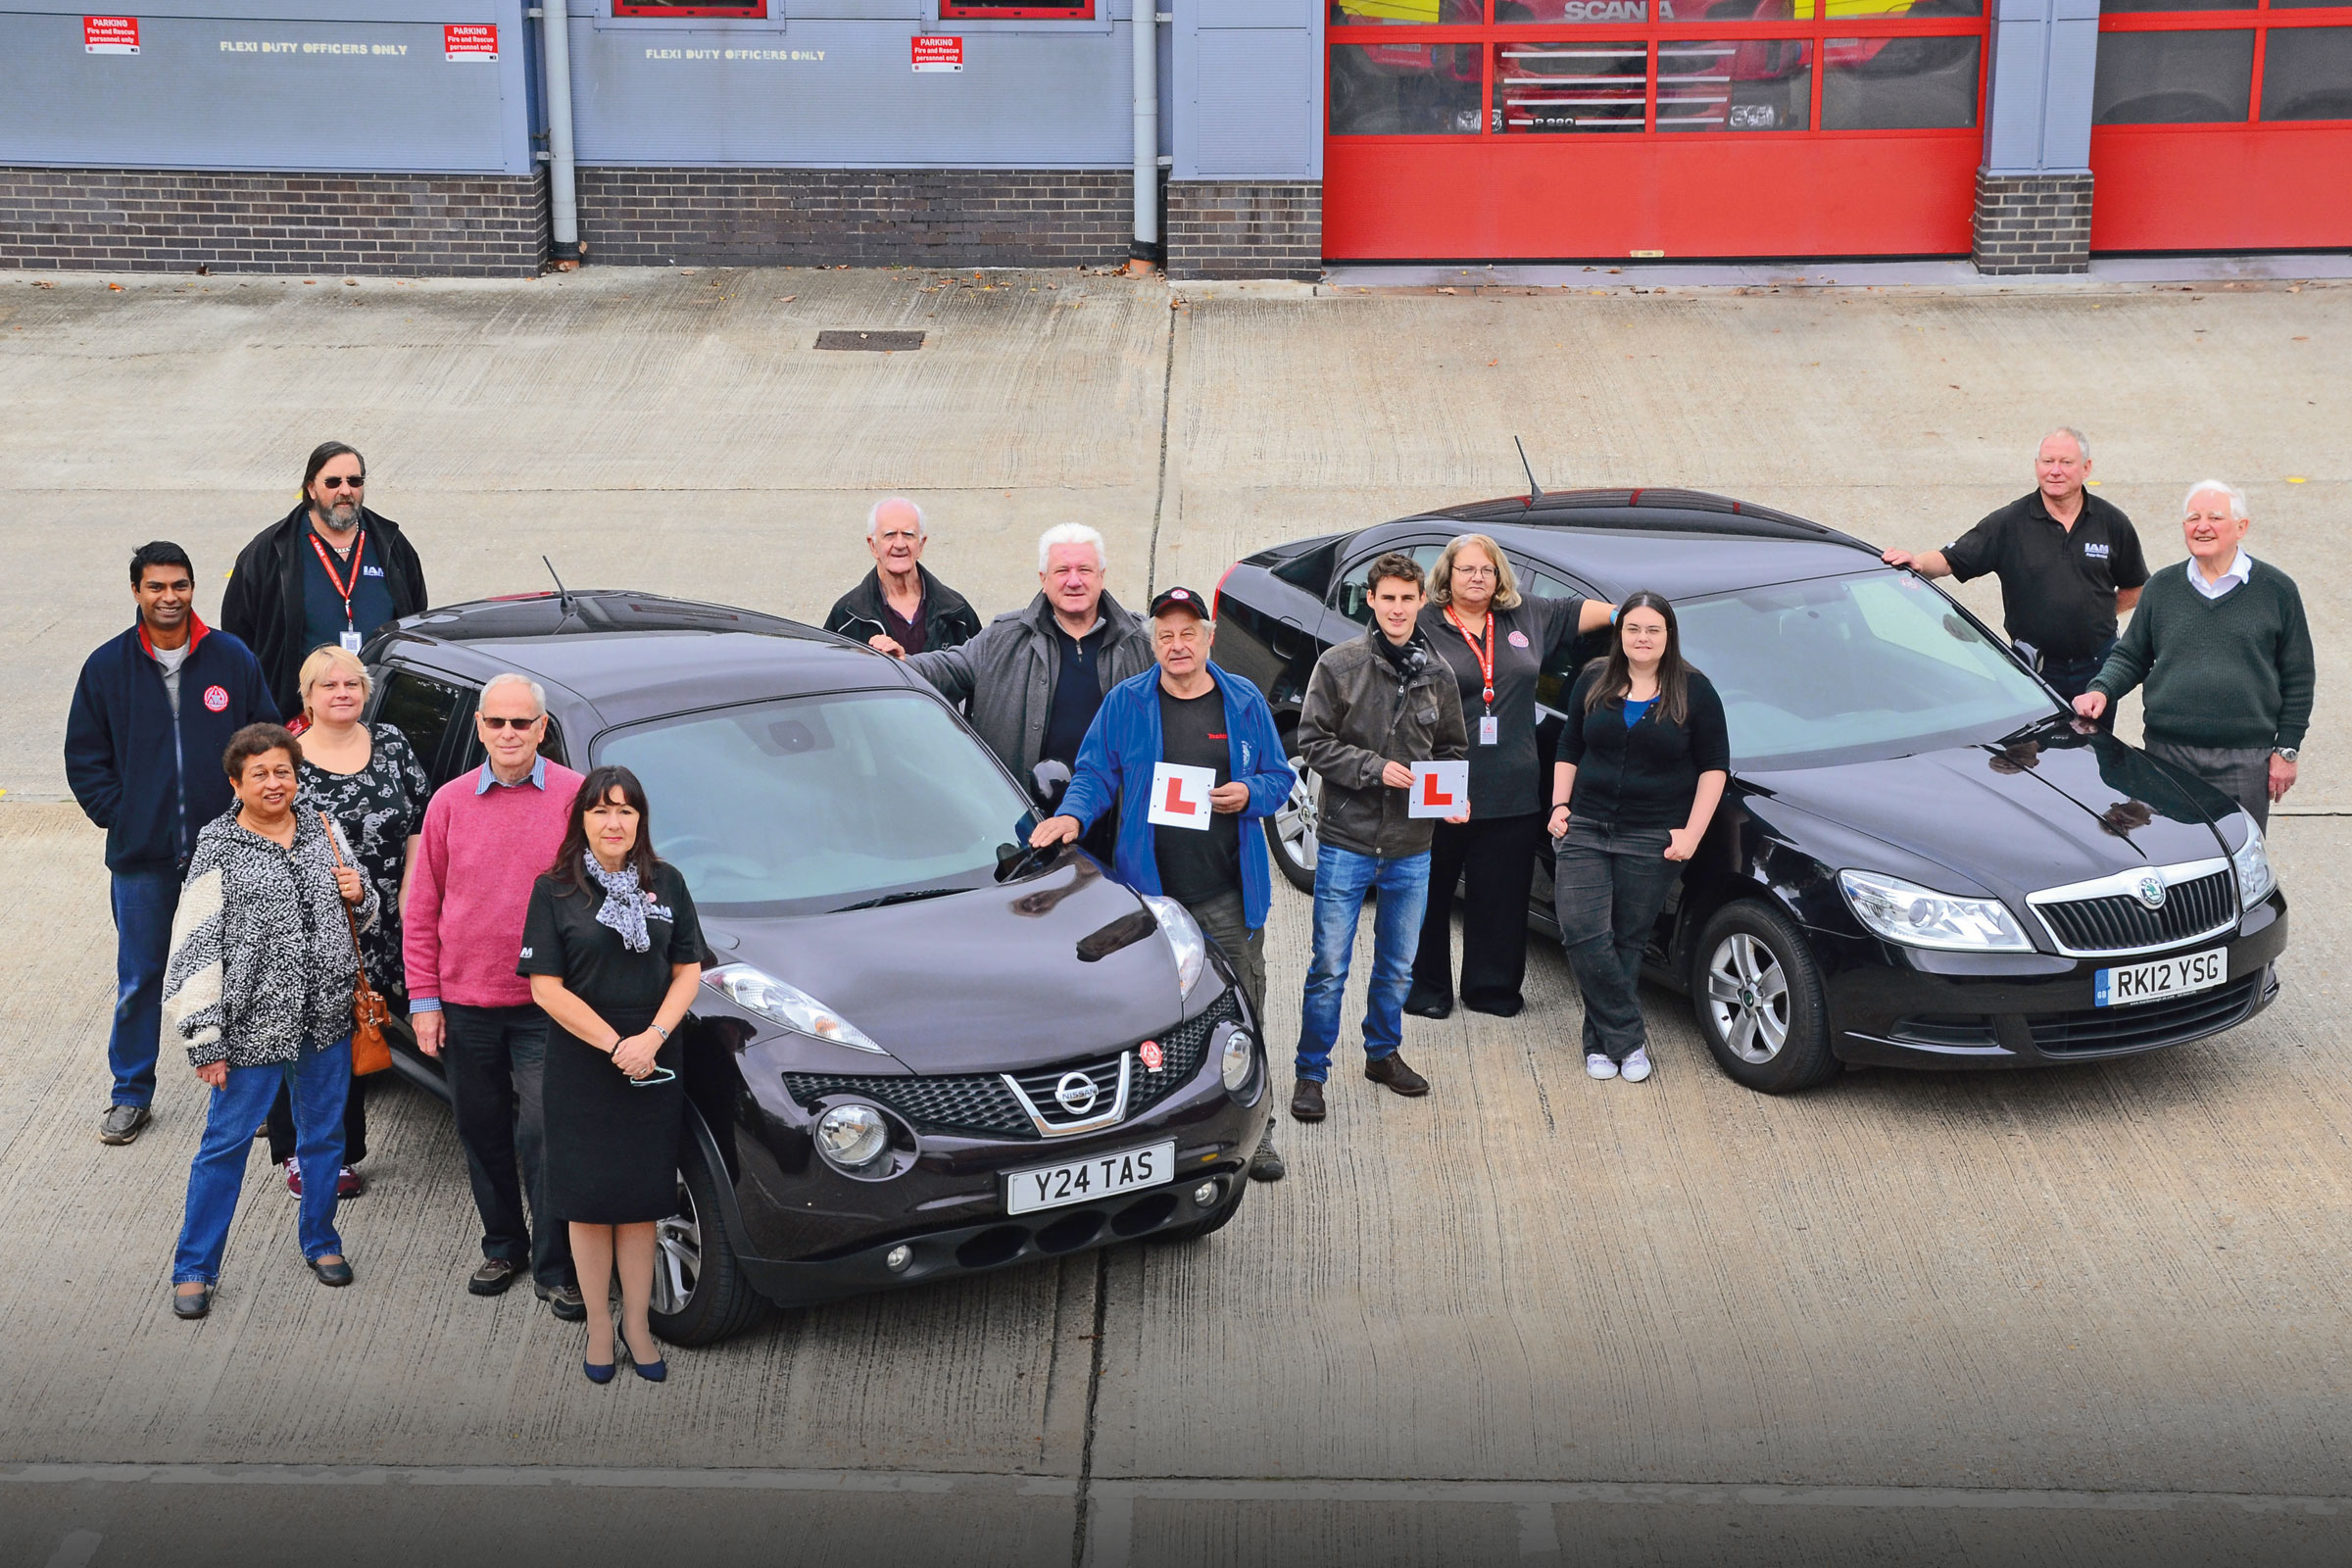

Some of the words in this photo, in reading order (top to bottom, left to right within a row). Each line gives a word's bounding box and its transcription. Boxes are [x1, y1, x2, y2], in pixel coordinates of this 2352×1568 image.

[1564, 1, 1675, 20] SCANA
[93, 19, 128, 27] PARKING
[454, 26, 488, 35] PARKING
[220, 41, 258, 52] FLEXI
[262, 42, 298, 53] DUTY
[302, 43, 368, 55] OFFICERS
[371, 44, 408, 56] ONLY
[645, 49, 682, 59] FLEXI
[686, 49, 720, 60] DUTY
[725, 50, 787, 61] OFFICERS
[791, 51, 825, 61] ONLY
[2084, 542, 2109, 555] IAM
[1165, 777, 1198, 815] L
[1424, 773, 1453, 806] L
[2118, 963, 2172, 998] RK12
[2179, 954, 2219, 986] YSG
[2097, 990, 2107, 1000] GB
[1062, 1087, 1097, 1100] NISSAN
[1035, 1164, 1091, 1201] Y24
[1101, 1151, 1153, 1189] TAS
